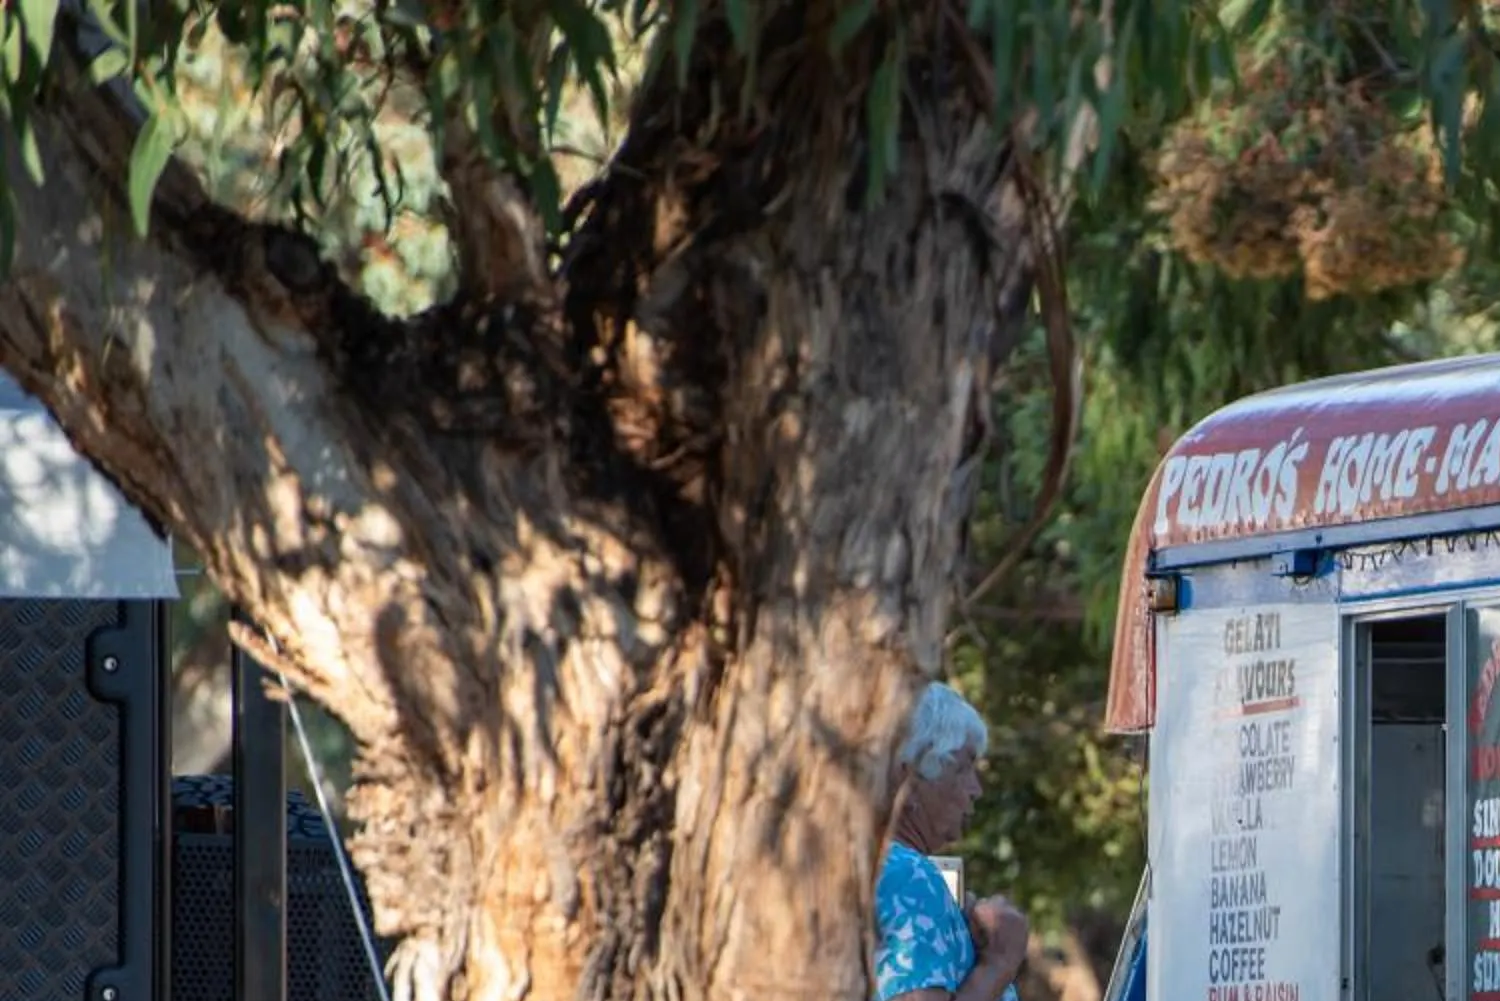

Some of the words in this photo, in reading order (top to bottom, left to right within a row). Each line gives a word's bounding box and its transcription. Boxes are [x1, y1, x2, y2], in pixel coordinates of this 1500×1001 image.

[1224, 613, 1281, 655] GELATI
[1210, 836, 1258, 872] LEMON
[1210, 871, 1268, 910] BANANA
[1209, 906, 1281, 946] HAZELNUT
[1208, 947, 1265, 985] COFFEE
